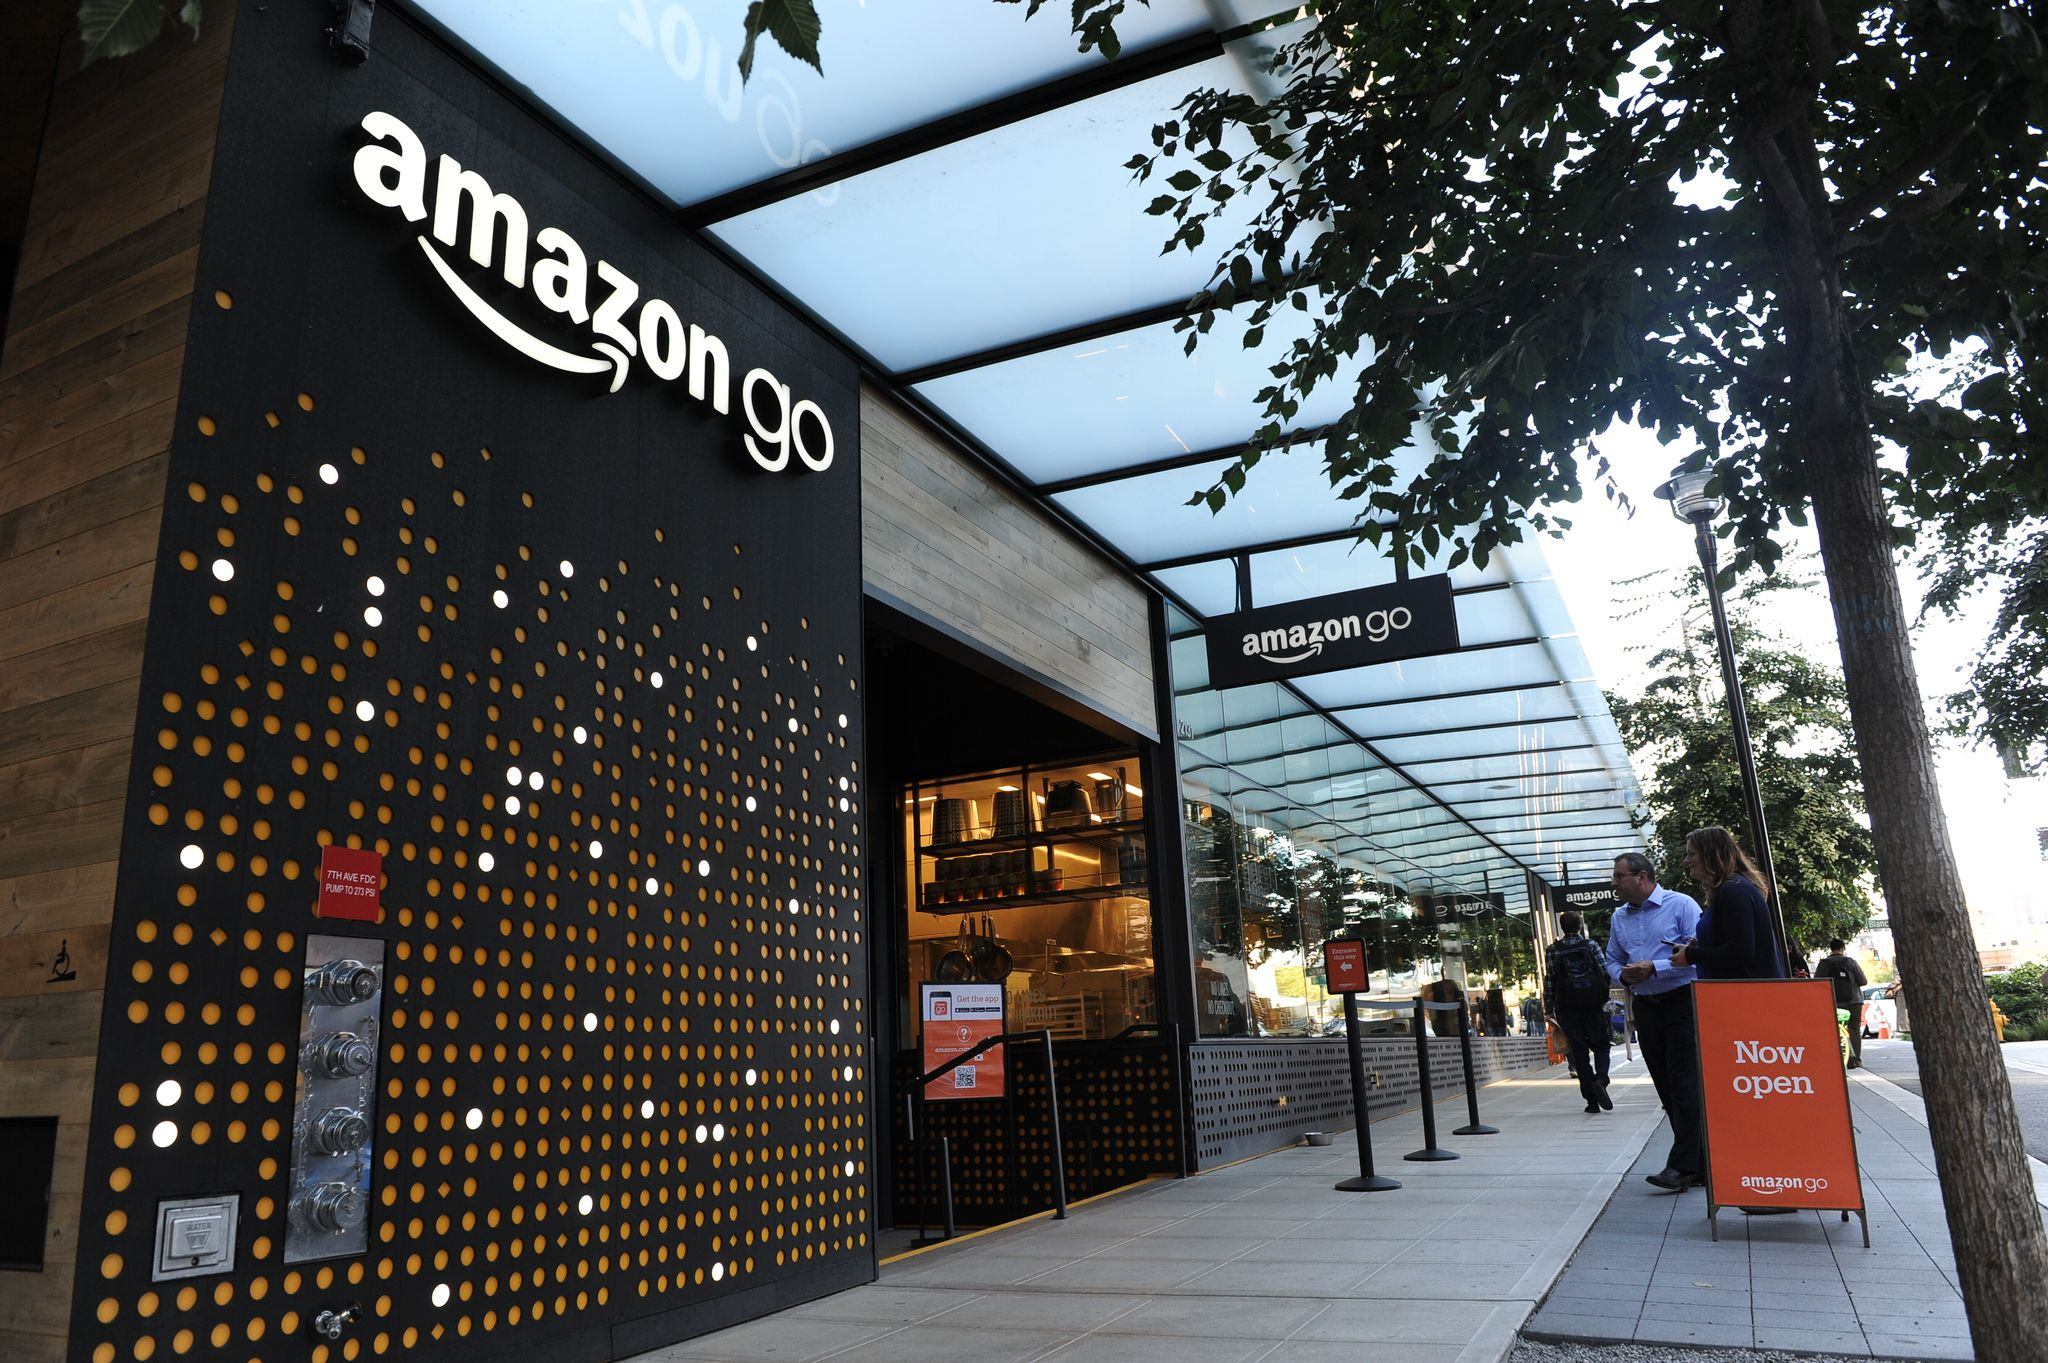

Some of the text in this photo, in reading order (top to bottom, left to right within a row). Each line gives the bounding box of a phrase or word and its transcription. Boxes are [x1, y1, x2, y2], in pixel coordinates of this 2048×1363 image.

[353, 110, 835, 473] amazon go
[1242, 606, 1412, 658] amazon go
[327, 870, 376, 885] 7TH AVE FDC
[325, 883, 376, 897] PUMP TO 273 PSI
[1566, 889, 1612, 905] amazon
[1868, 919, 1890, 929] Blanc
[957, 995, 999, 1004] Get the app
[1733, 1039, 1805, 1064] Now
[1732, 1074, 1814, 1100] open
[1741, 1174, 1828, 1193] amazon go
